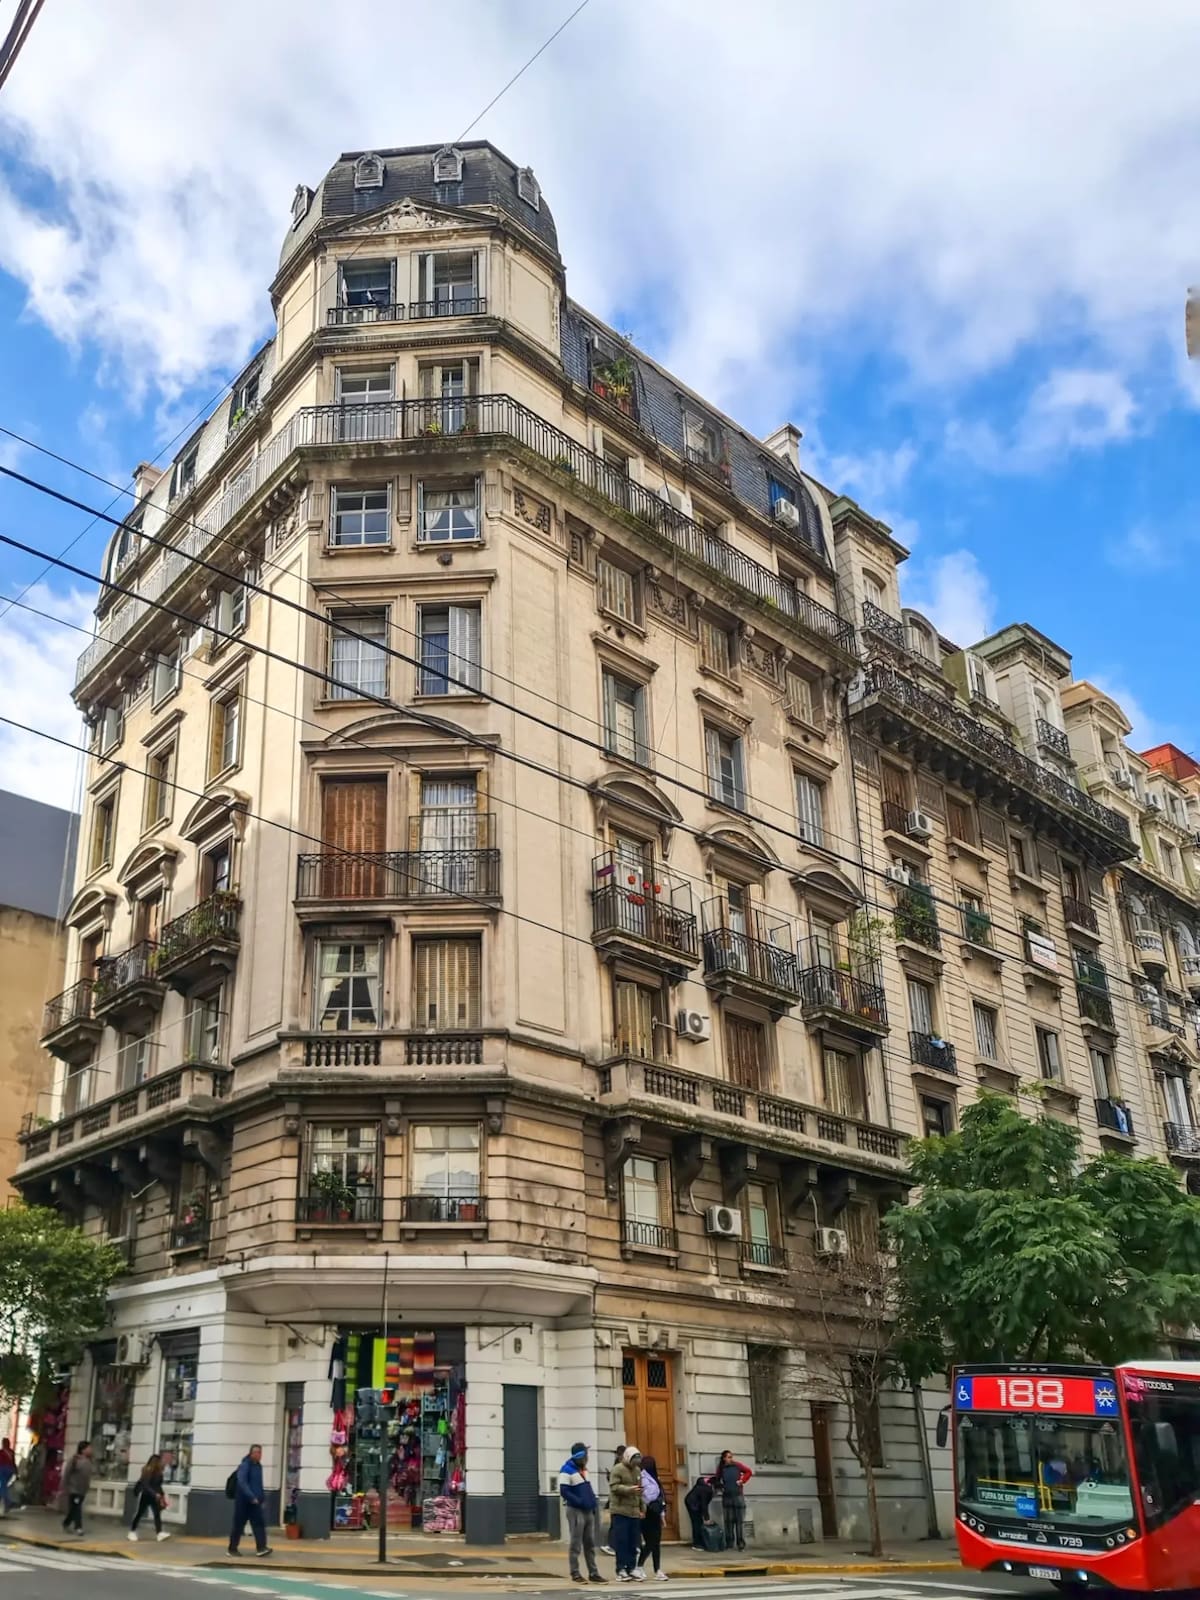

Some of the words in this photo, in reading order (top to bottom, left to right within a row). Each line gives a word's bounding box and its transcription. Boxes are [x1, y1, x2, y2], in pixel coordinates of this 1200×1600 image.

[1143, 1380, 1175, 1391] TODOBUS
[997, 1379, 1064, 1408] 188
[981, 1491, 997, 1500] FUERA
[997, 1493, 1004, 1501] DE
[1059, 1536, 1083, 1547] 1739
